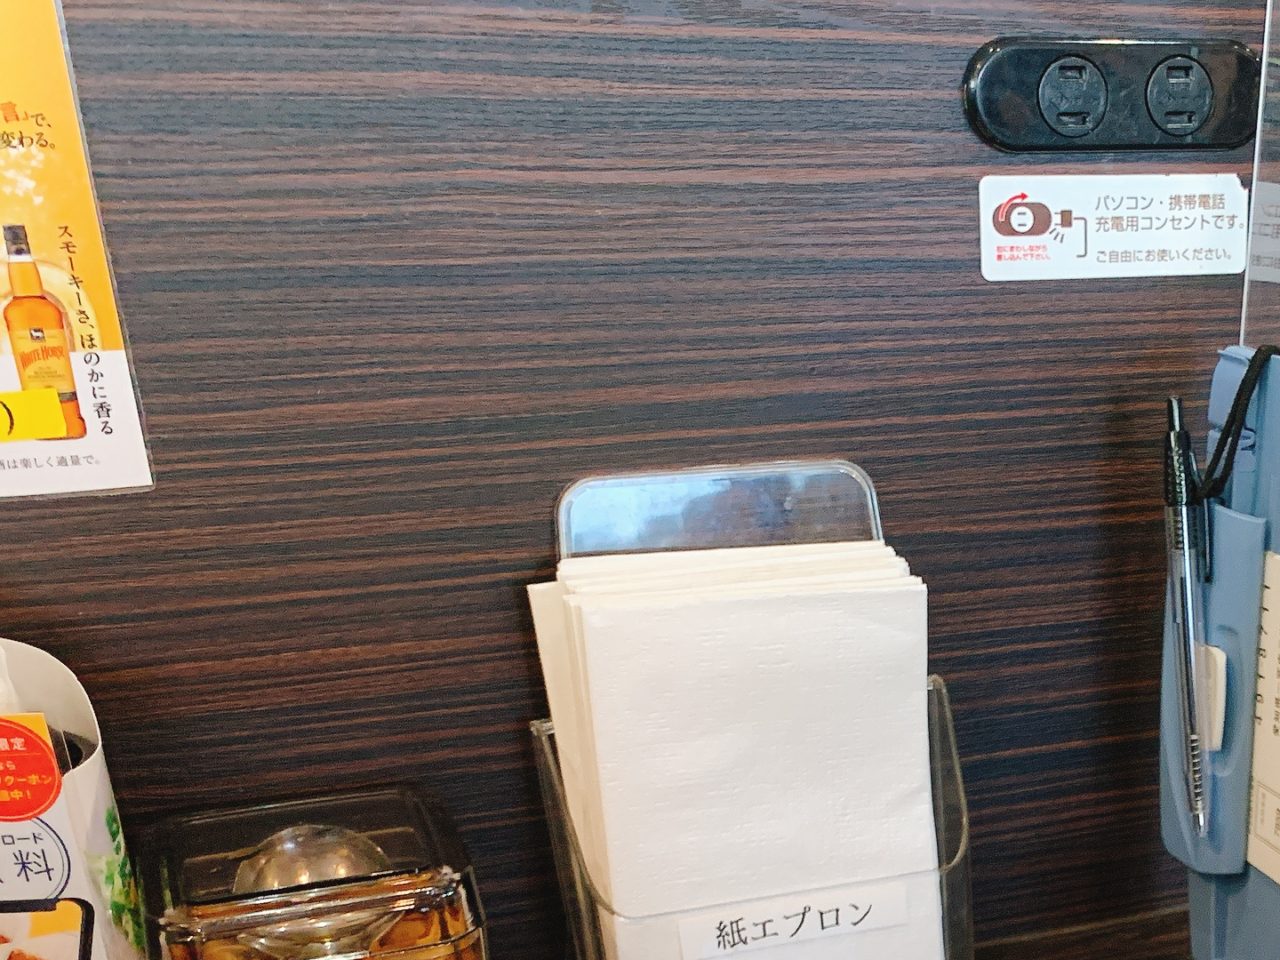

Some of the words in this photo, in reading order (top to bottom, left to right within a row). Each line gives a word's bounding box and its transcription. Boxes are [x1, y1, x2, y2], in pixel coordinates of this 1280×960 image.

[1095, 193, 1226, 212] パソコン・携帯電話
[1095, 213, 1245, 232] 充電用コンセントです。
[1096, 248, 1232, 264] ご自由にお使いください。
[58, 224, 114, 436] スモーキーさ、ほのかに香る
[715, 904, 872, 950] 紙エプロン
